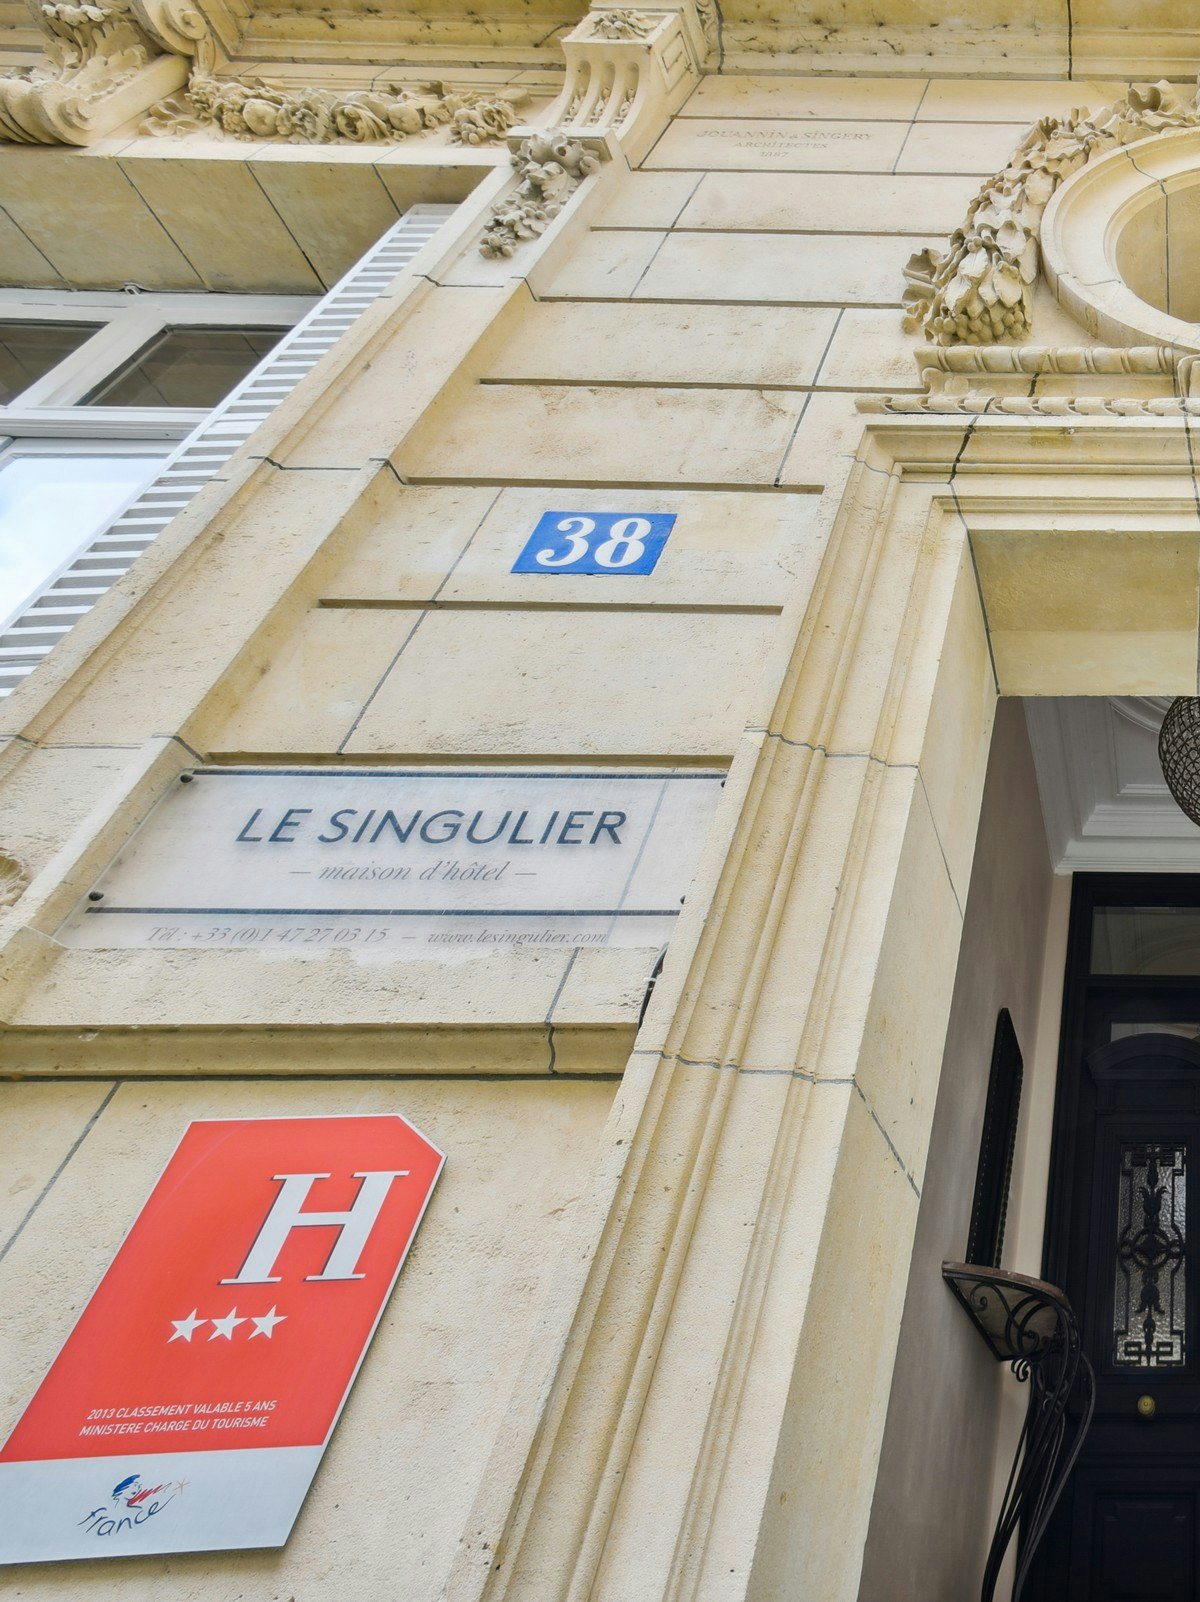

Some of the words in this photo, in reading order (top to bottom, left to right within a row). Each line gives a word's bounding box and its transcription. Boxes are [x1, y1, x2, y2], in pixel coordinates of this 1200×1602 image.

[734, 140, 829, 149] ARCHITECTES
[536, 517, 651, 568] 38
[235, 808, 313, 843] LE
[317, 809, 627, 845] SINGULIER
[317, 860, 412, 881] maison
[192, 927, 232, 942] +33
[276, 927, 307, 943] 47
[304, 927, 336, 943] 27
[333, 927, 362, 943] 03
[364, 927, 391, 943] 15
[427, 929, 608, 947] www.lesingulier.com
[217, 1169, 411, 1286] H
[86, 1408, 115, 1420] 2013
[115, 1403, 193, 1419] CLASSEMENT
[193, 1401, 244, 1415] VALABLE
[243, 1400, 252, 1413] 5
[252, 1400, 277, 1412] ANS
[78, 1422, 142, 1437] MINISTERE
[143, 1419, 194, 1433] CHARGE
[191, 1418, 209, 1430] DU
[212, 1415, 270, 1430] TOURISME
